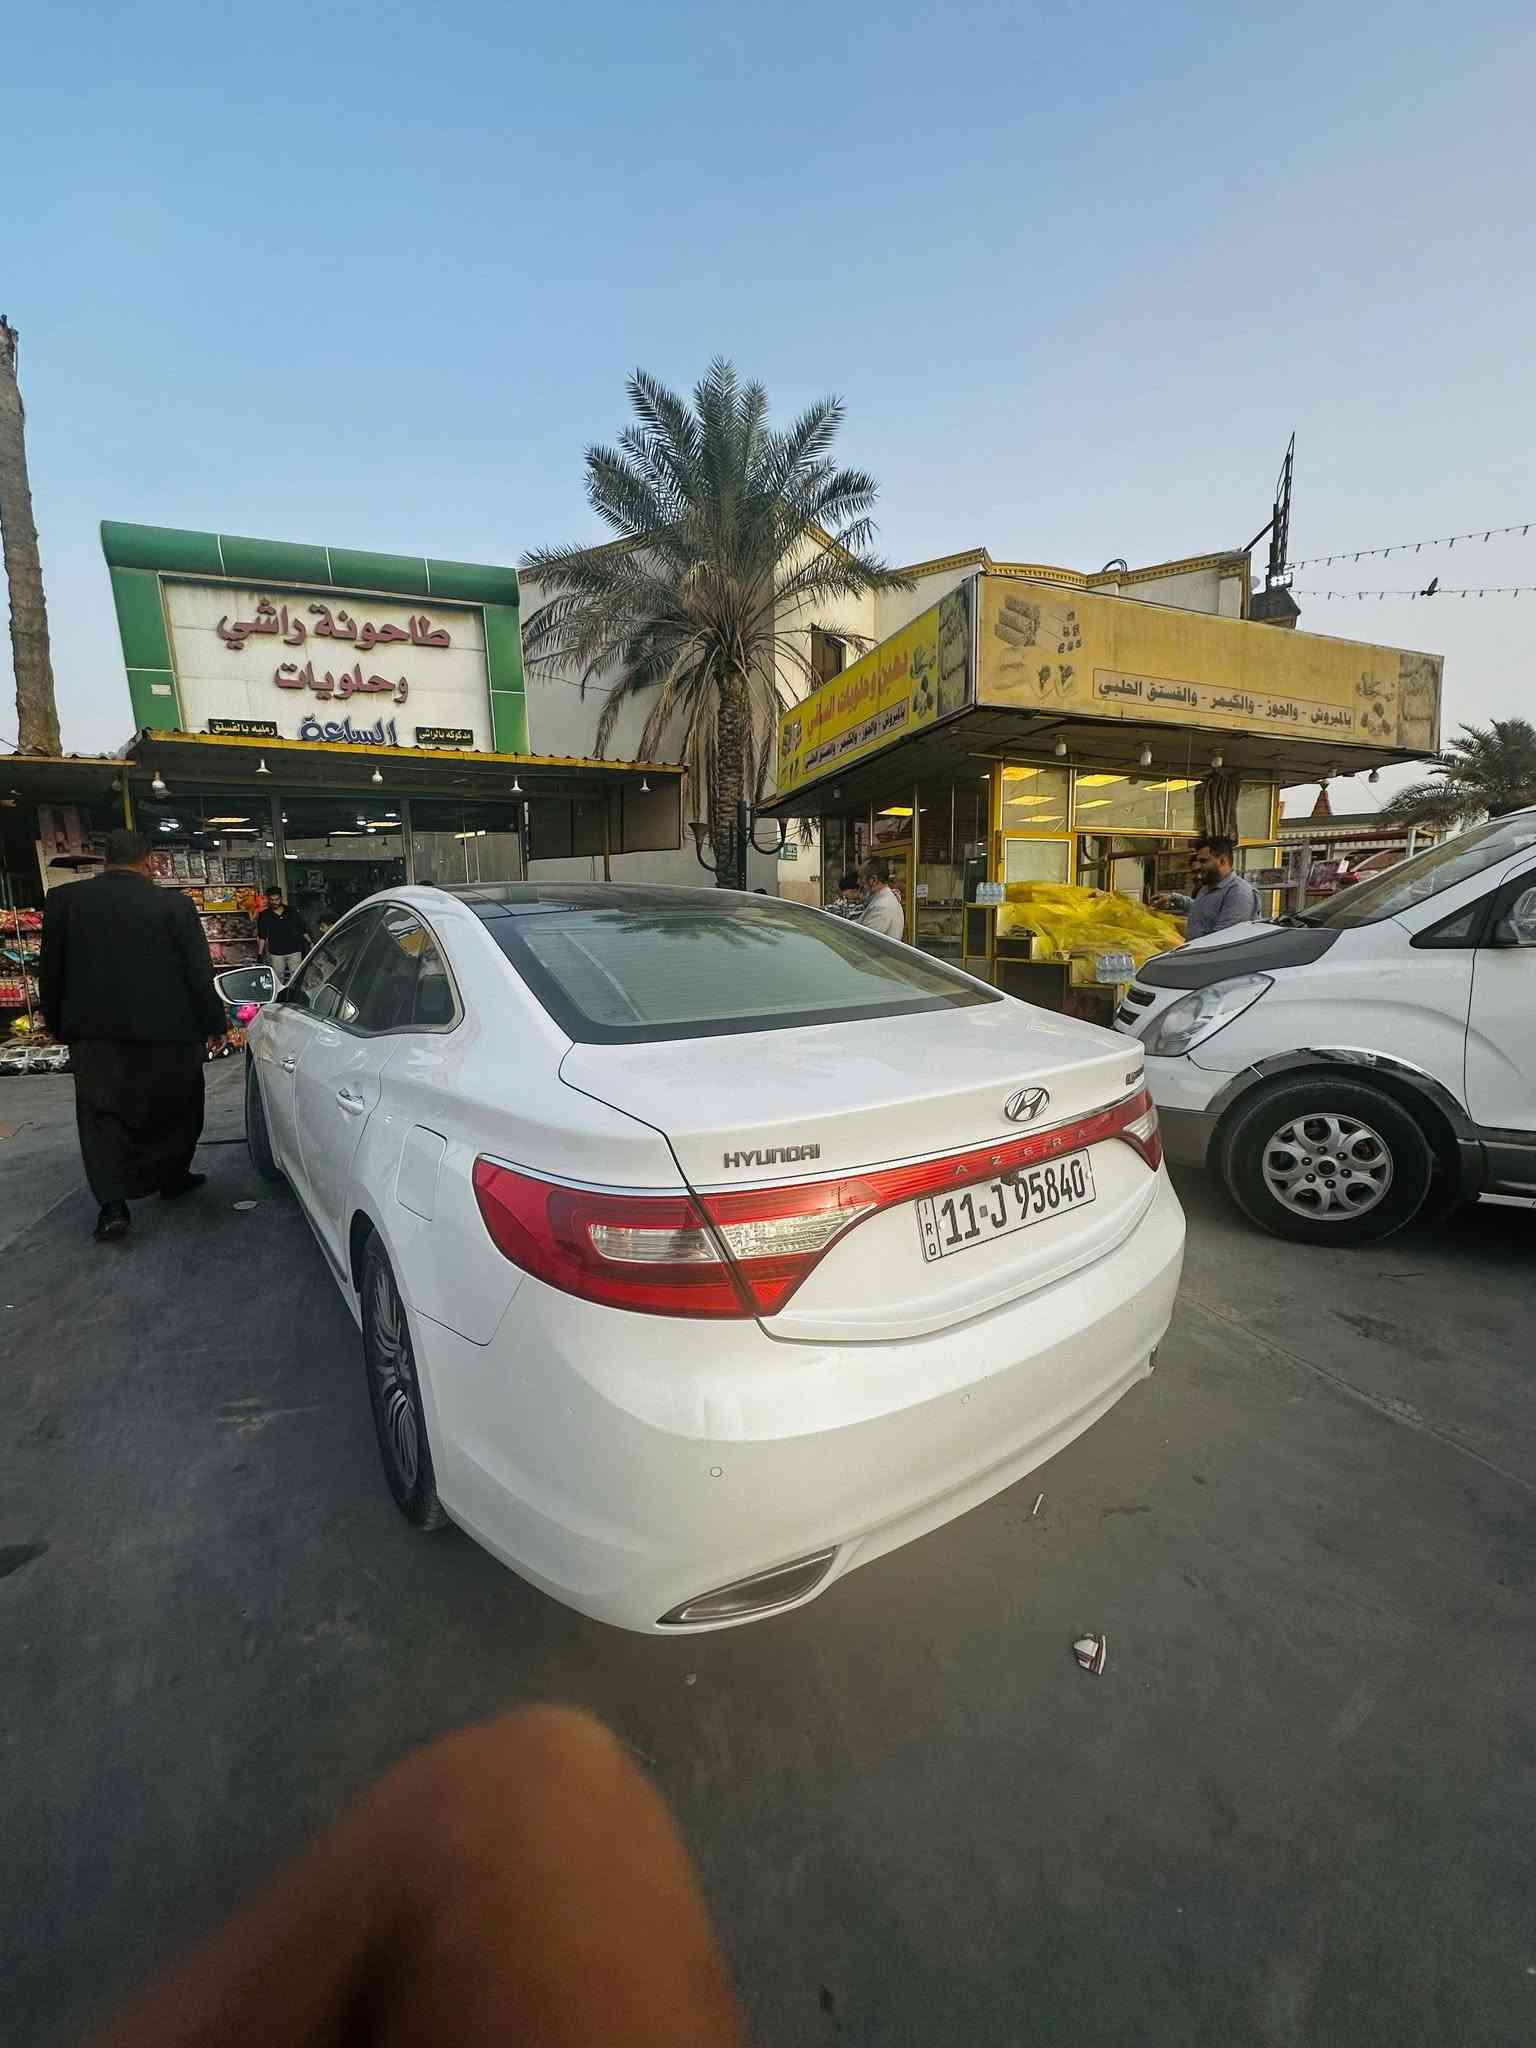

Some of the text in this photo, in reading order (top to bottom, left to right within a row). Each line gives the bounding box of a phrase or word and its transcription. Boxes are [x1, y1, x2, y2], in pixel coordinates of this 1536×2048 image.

[217, 597, 451, 650] طاحونة راشي
[274, 659, 409, 704] وحلويات
[1098, 679, 1143, 699] الحلبي
[1146, 682, 1198, 707] والفستق
[300, 711, 398, 745] الساعة
[723, 1143, 821, 1169] HYUNDAI
[1014, 1159, 1086, 1220] 95840
